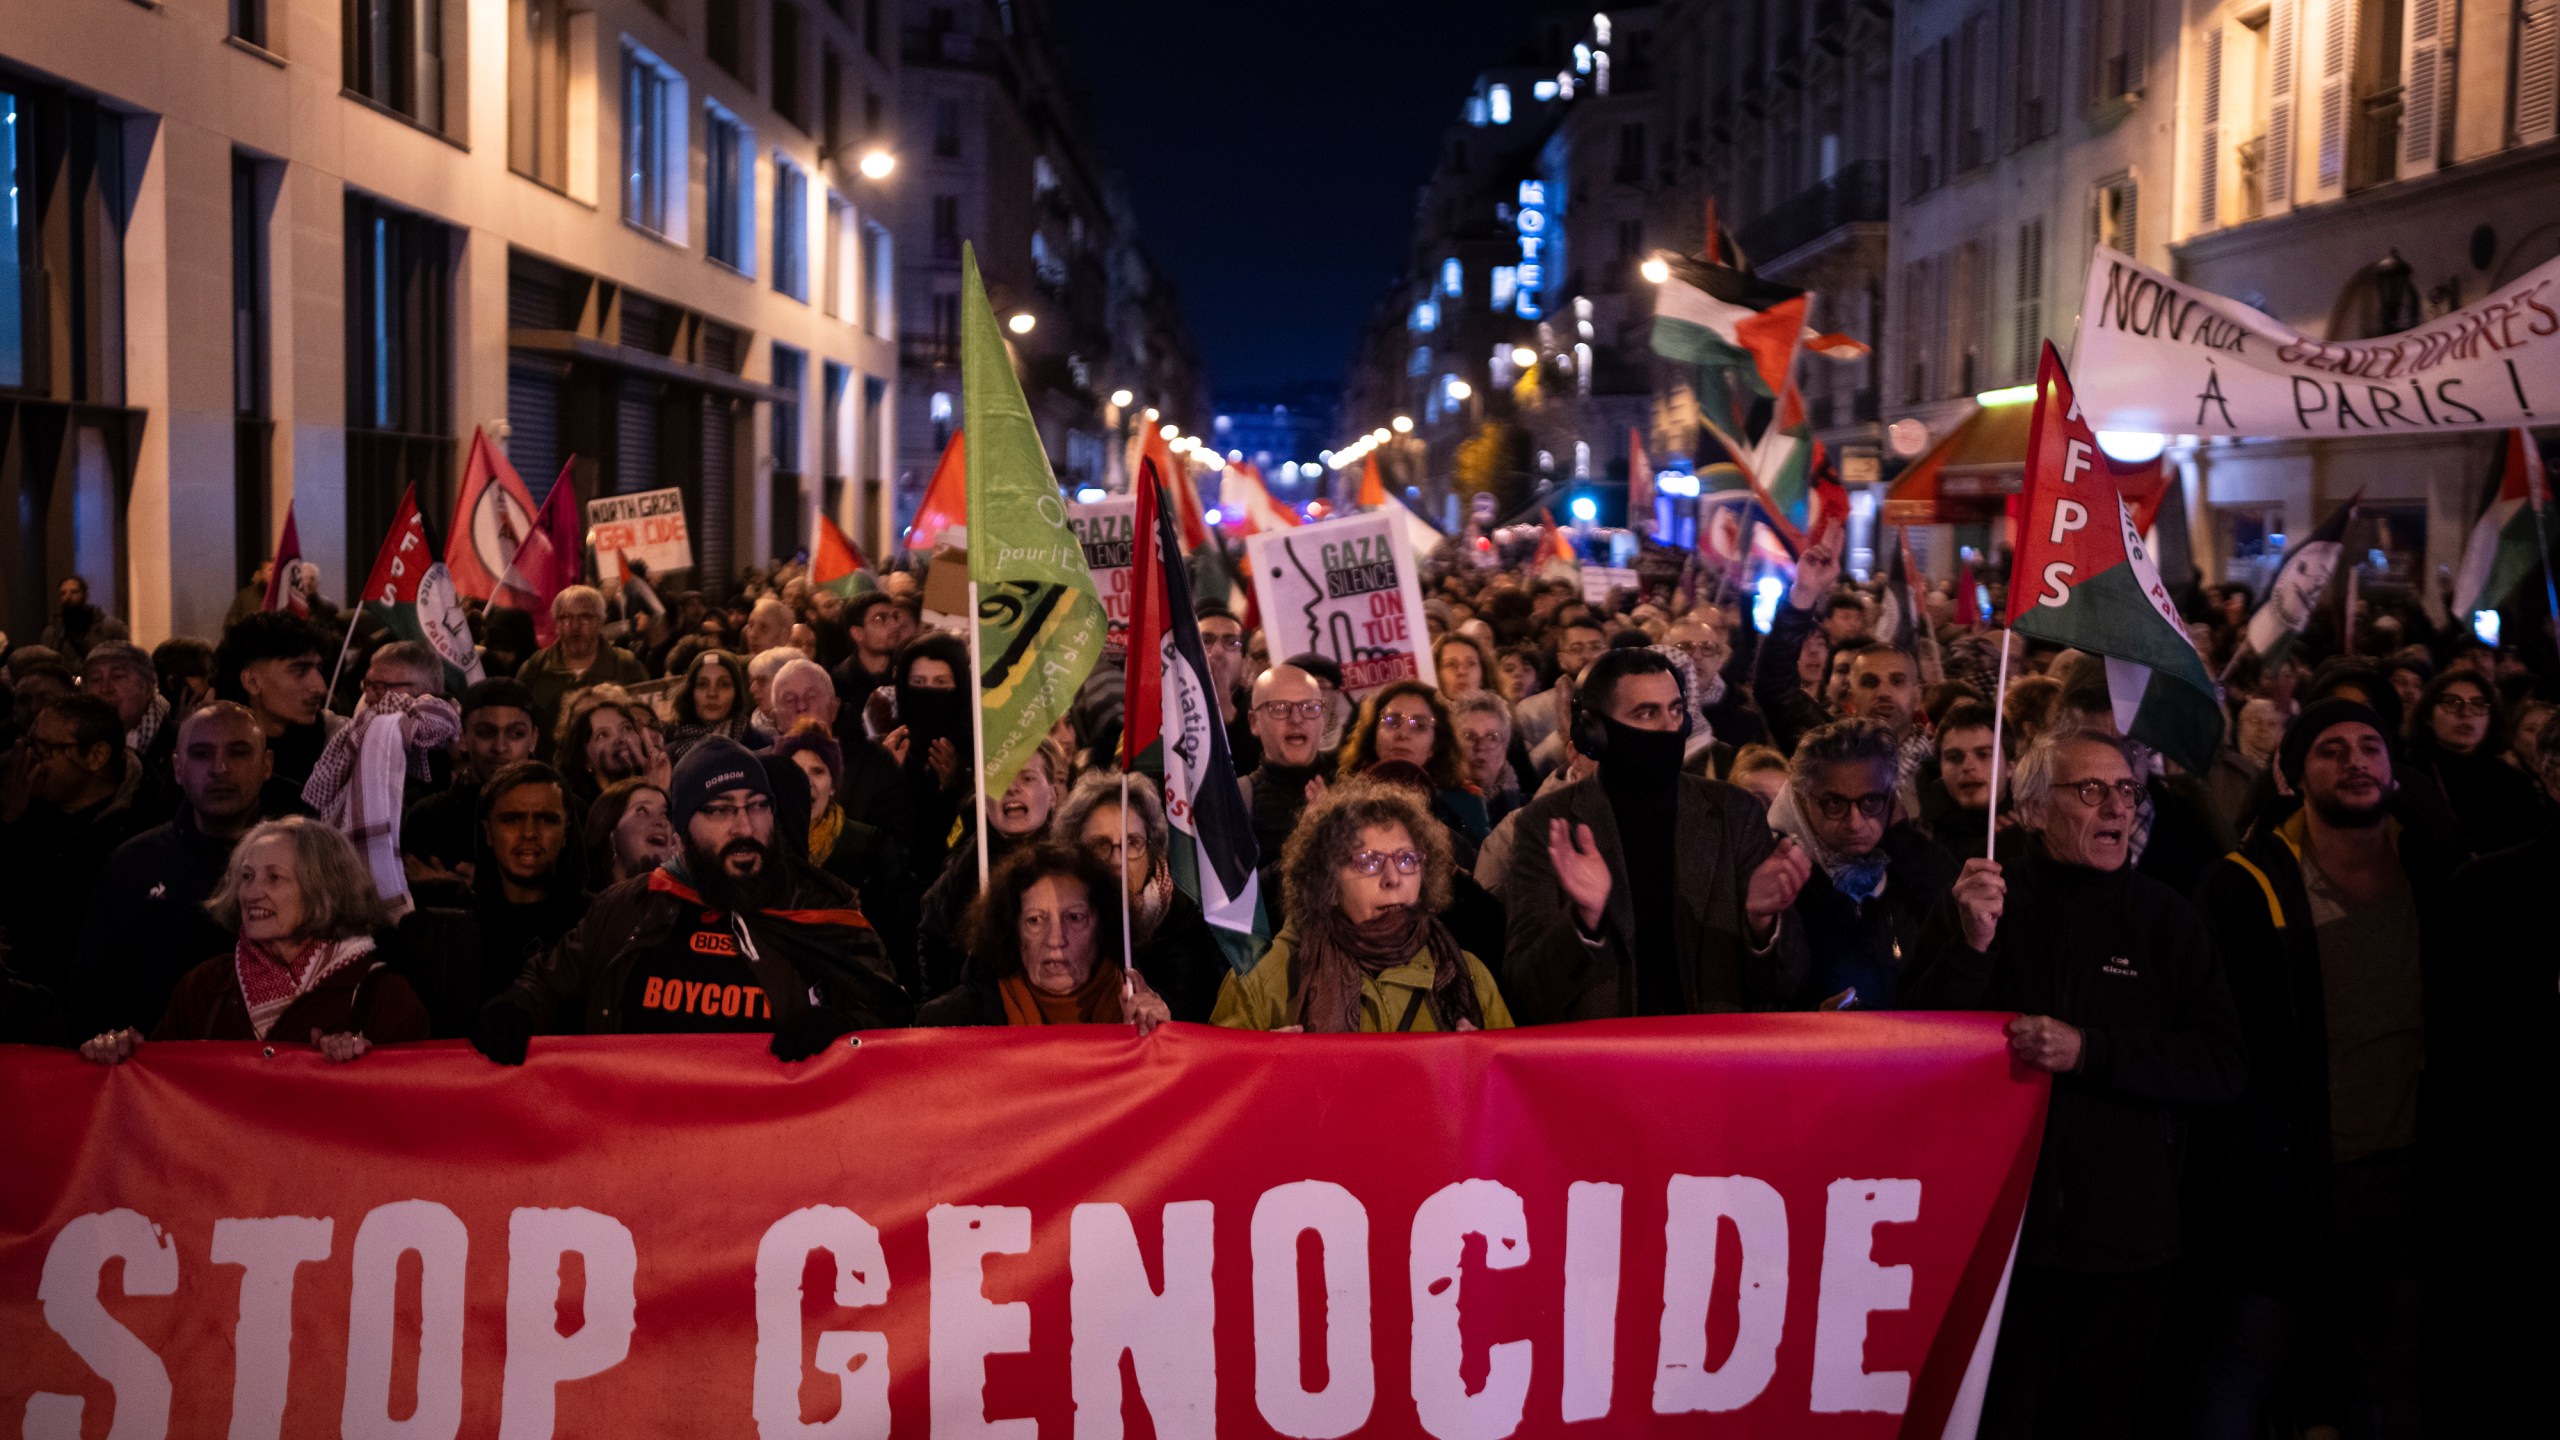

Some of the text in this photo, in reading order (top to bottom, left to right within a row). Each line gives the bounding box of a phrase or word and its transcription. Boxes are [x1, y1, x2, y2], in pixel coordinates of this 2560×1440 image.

[1517, 179, 1545, 319] HOTEL
[2098, 261, 2199, 340] NON
[2191, 314, 2253, 353] AUX
[2197, 356, 2237, 428] À
[590, 491, 681, 523] NORTH GAZA
[997, 547, 1047, 570] pour
[1320, 533, 1392, 571] GAZA
[1328, 562, 1398, 598] SILENCE
[1368, 589, 1405, 619] ON
[1362, 615, 1409, 646] TUE
[704, 770, 744, 789] DOBSOM
[20, 1173, 1922, 1440] STOP GENOCIDE
